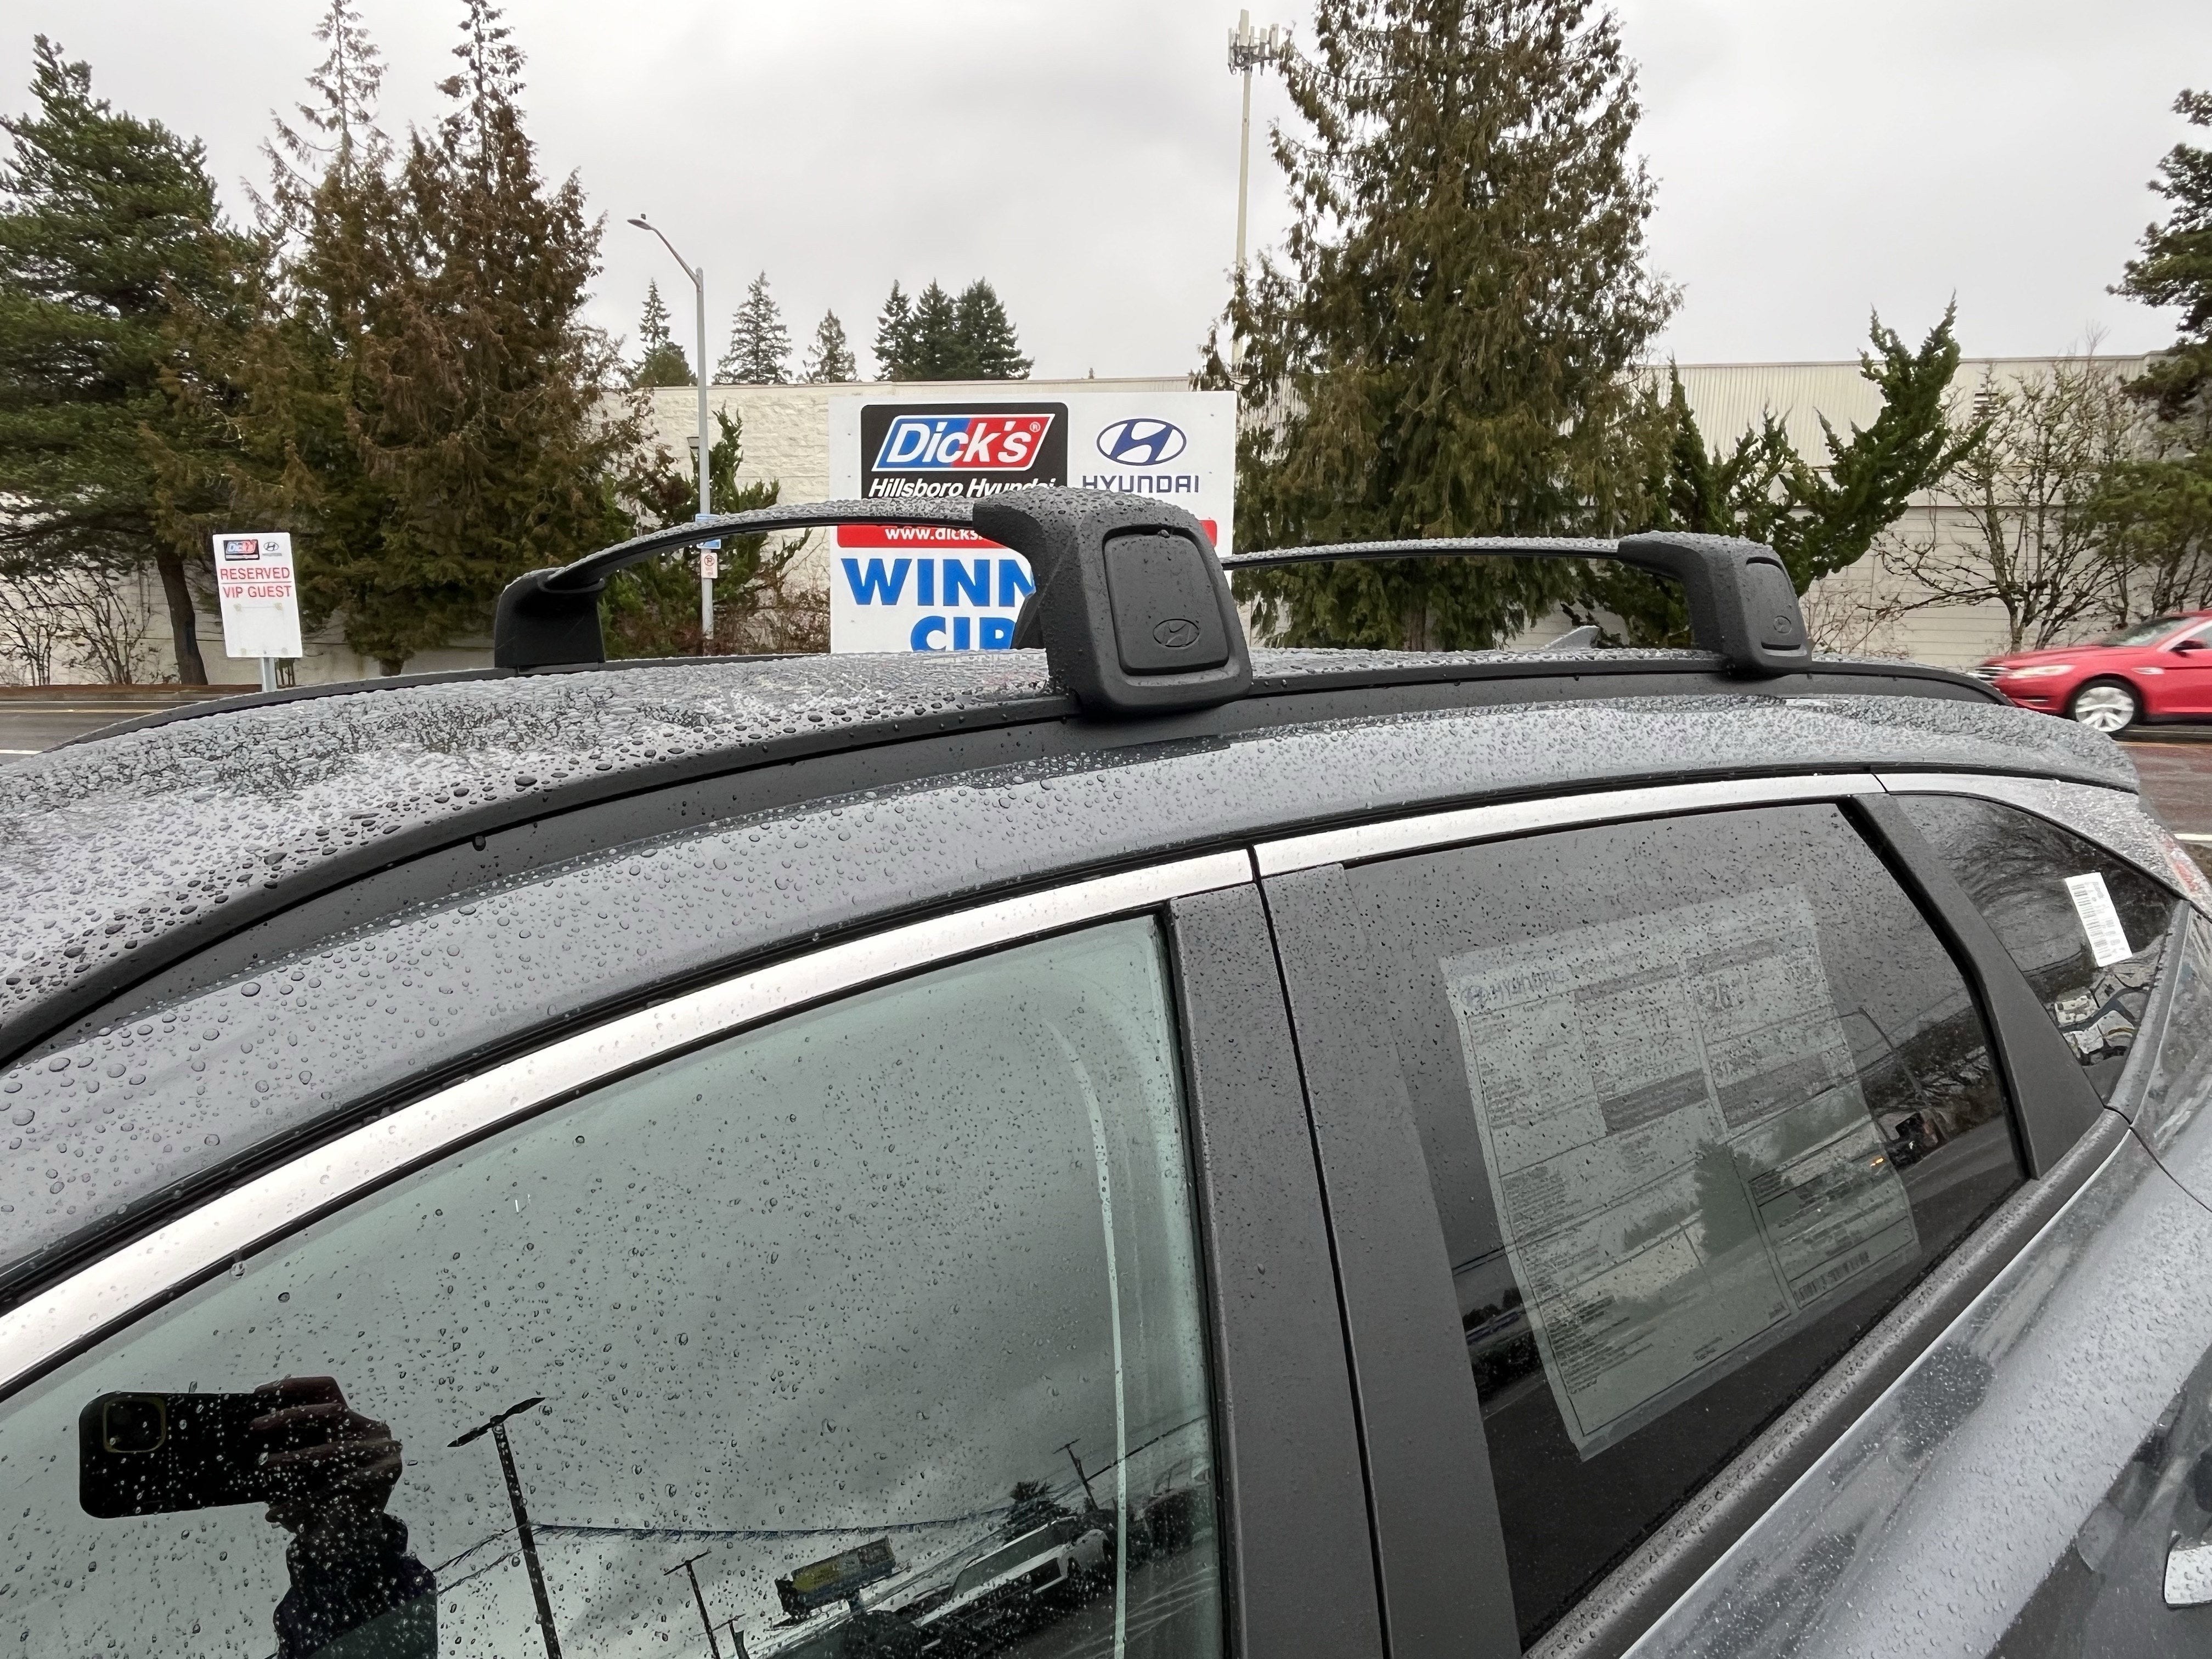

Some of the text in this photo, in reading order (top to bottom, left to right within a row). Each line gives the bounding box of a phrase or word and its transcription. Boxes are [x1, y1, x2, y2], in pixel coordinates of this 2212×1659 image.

[868, 478, 963, 498] Hillsboro
[1082, 475, 1199, 493] HYUNDAI
[884, 528, 983, 540] www.dicks
[220, 567, 290, 580] RESERVED
[223, 585, 292, 598] VIP GUEST
